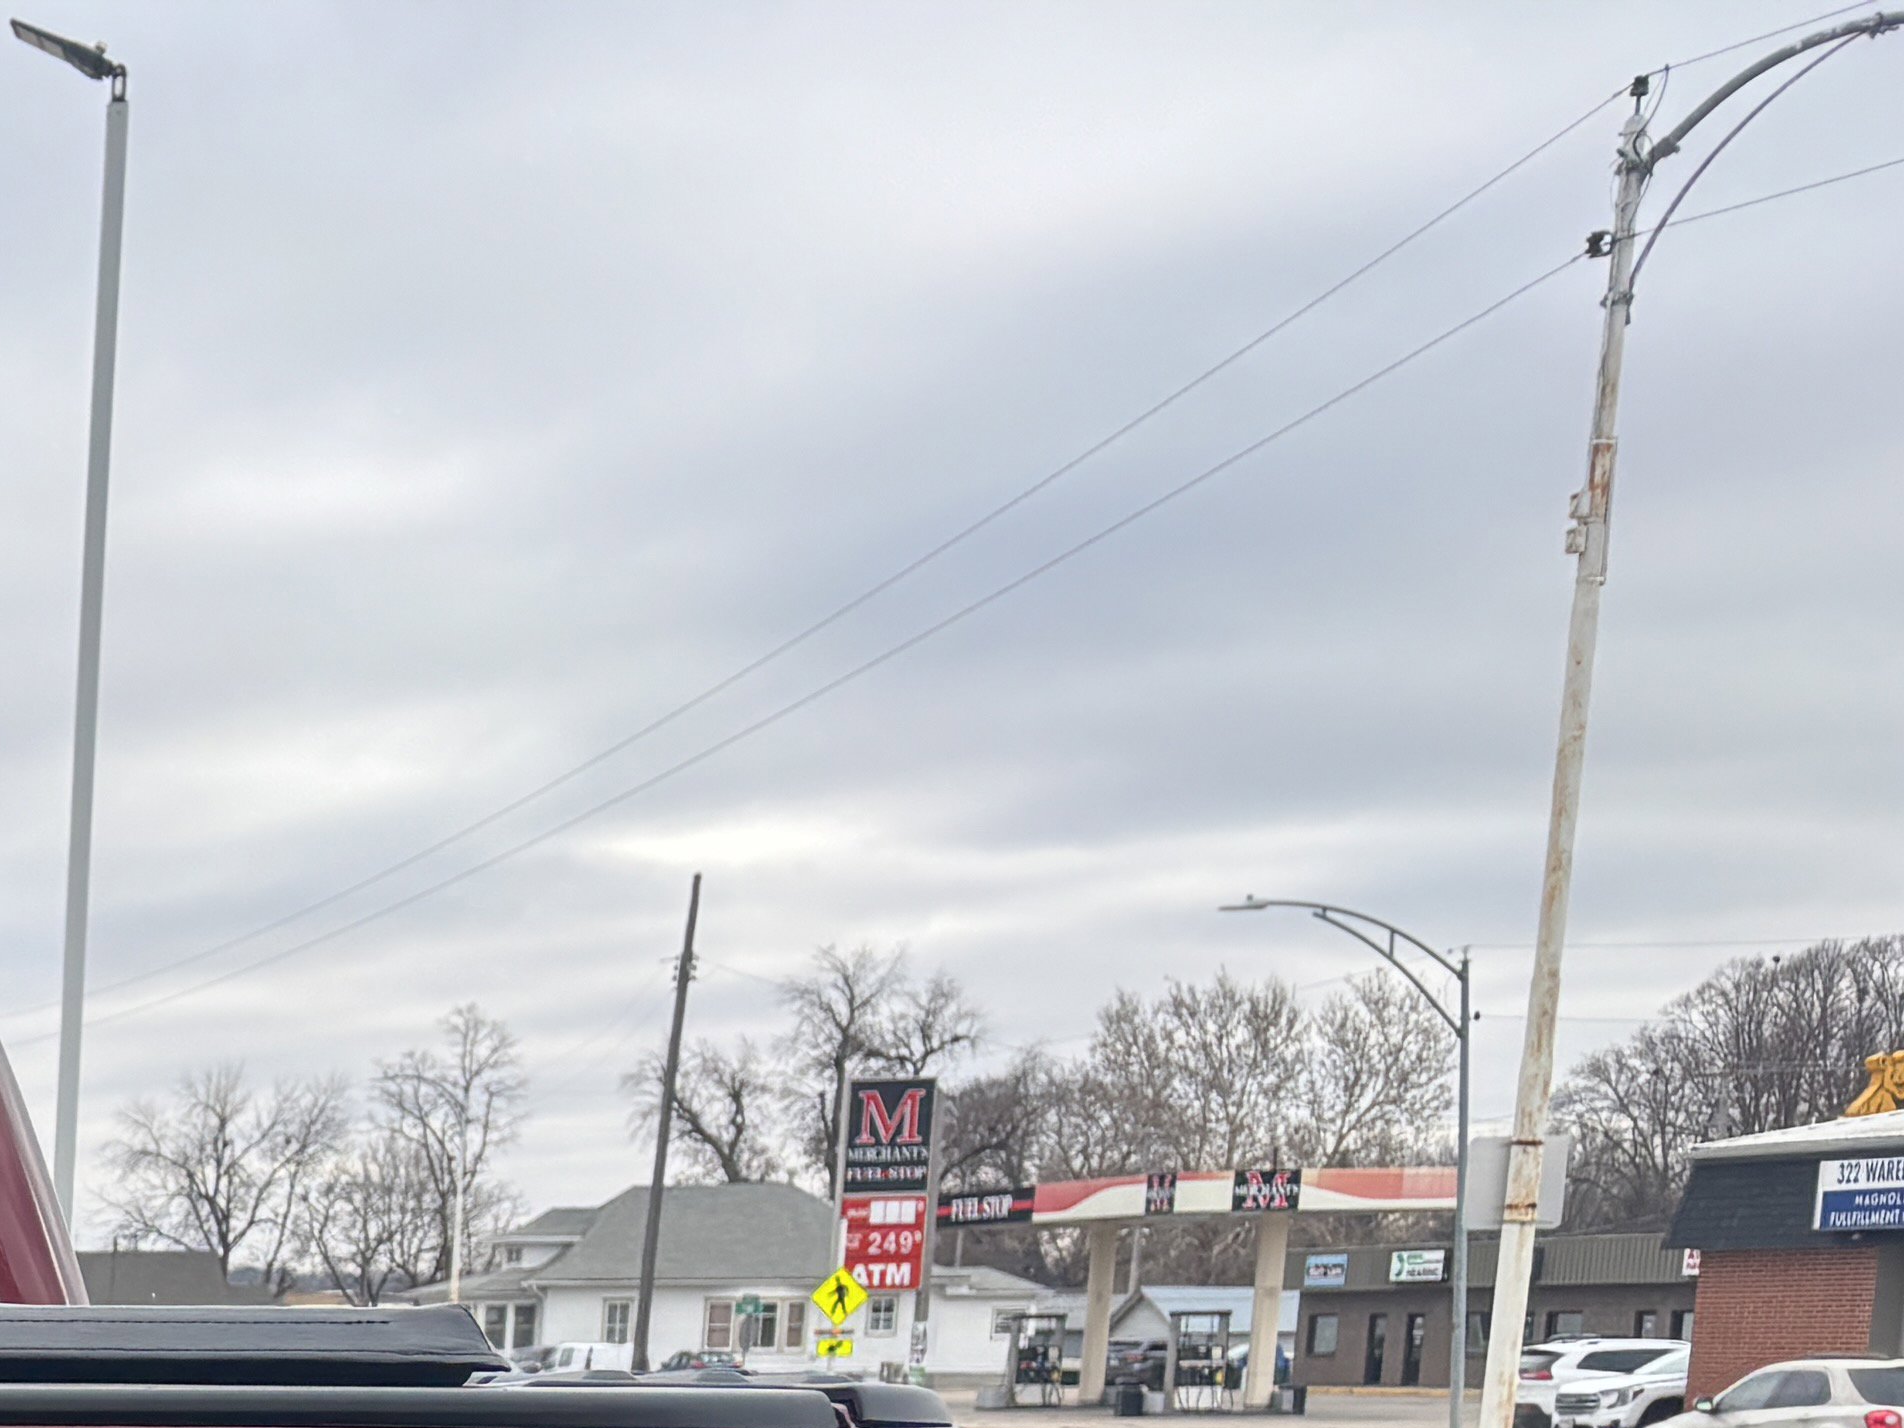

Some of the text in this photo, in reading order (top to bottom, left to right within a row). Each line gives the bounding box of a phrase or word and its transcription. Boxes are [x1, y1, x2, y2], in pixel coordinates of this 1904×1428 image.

[855, 1088, 926, 1144] M
[1837, 1160, 1904, 1184] 322 WARE
[982, 1194, 1013, 1219] STOP
[1854, 1192, 1904, 1207] MAGNOL
[852, 1263, 912, 1287] ATM
